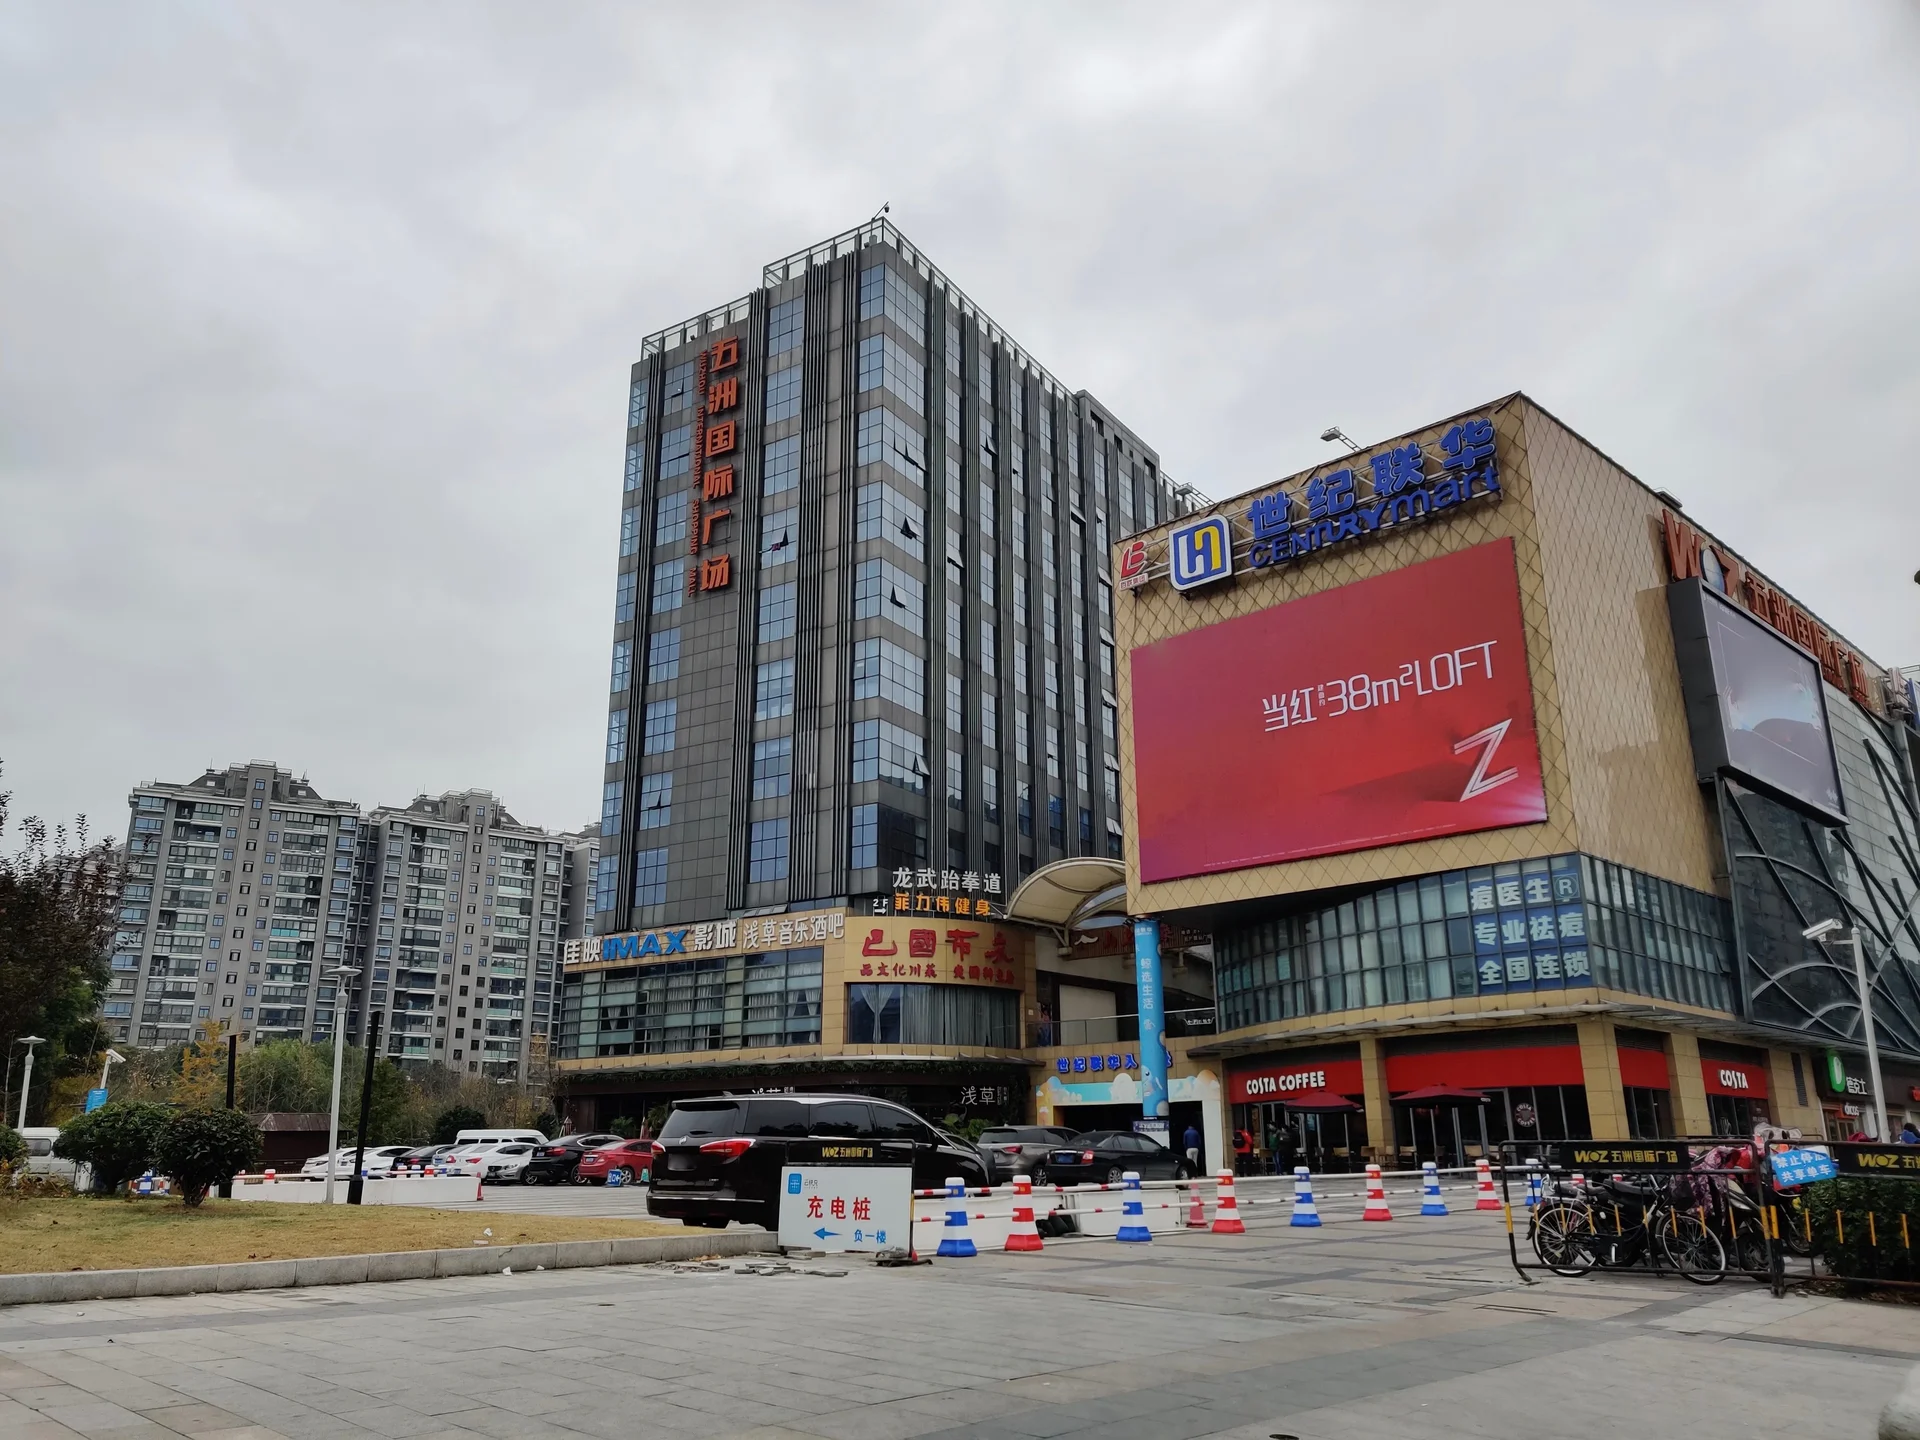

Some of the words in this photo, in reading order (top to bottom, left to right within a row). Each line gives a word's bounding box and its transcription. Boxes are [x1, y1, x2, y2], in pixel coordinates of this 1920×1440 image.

[699, 335, 738, 592] 五洲国际广场
[1247, 417, 1496, 540] 世纪联华
[689, 498, 700, 556] SHOPPING
[1262, 686, 1318, 733] 当红
[892, 866, 1002, 894] 龙武跆拳道
[895, 892, 991, 917] 菲力伟健身
[1470, 878, 1552, 911] 痘医生
[743, 912, 845, 950] 浅草音乐酒吧
[1474, 911, 1585, 946] 专业祛痘
[1479, 950, 1591, 986] 全国连锁
[1246, 1077, 1277, 1095] COSTA
[1278, 1071, 1326, 1092] COFFEE
[1719, 1069, 1749, 1091] COSTA
[961, 1086, 995, 1105] 浅草
[840, 1147, 873, 1158] 五洲国际广场
[1611, 1150, 1678, 1164] 五洲国际广场
[1857, 1153, 1900, 1169] WOZ
[1781, 1164, 1832, 1182] 共享单车
[807, 1195, 872, 1221] 充电桩
[854, 1229, 887, 1244] 负一楼
